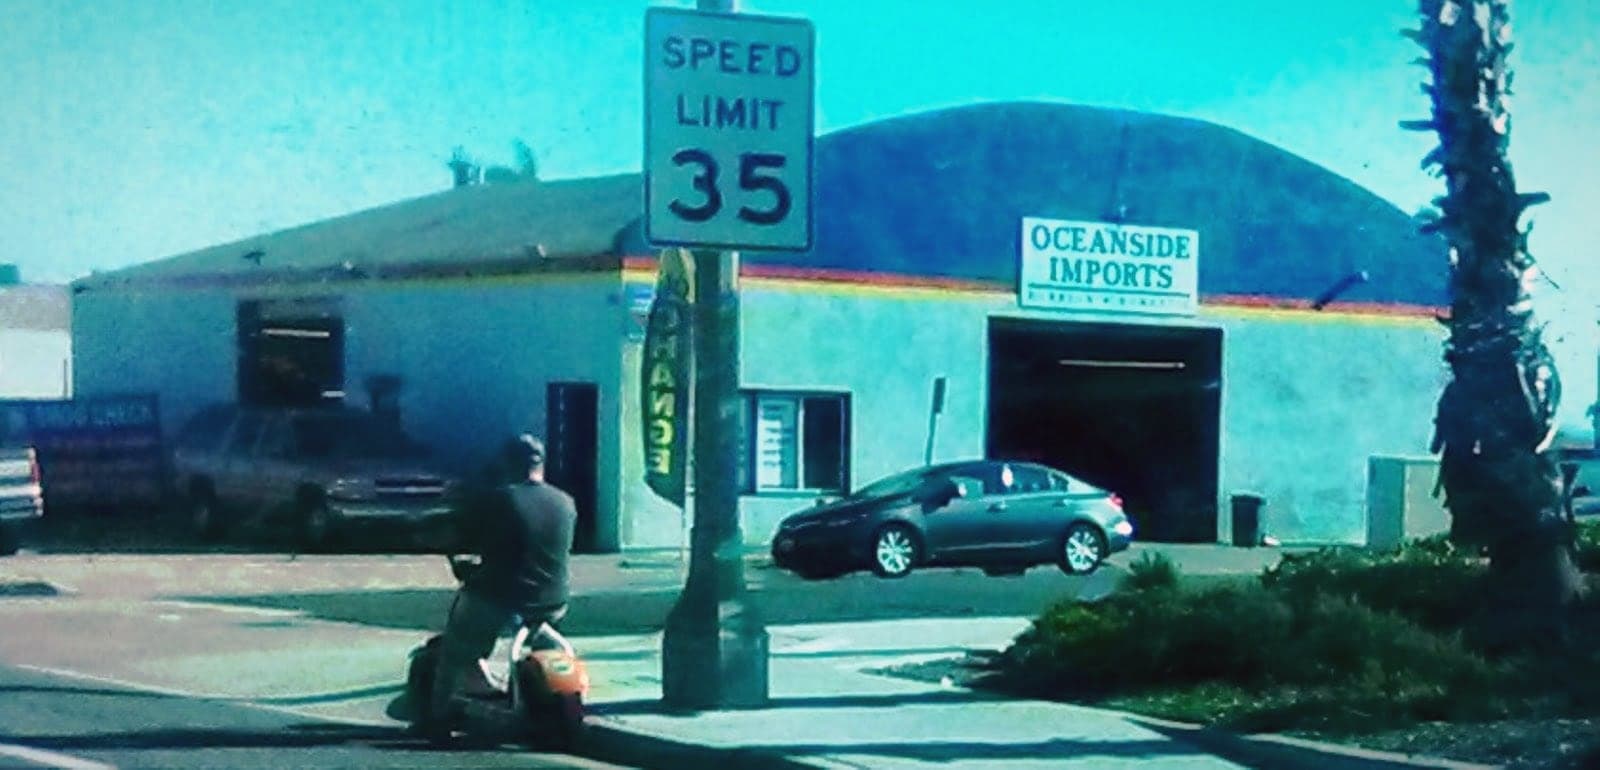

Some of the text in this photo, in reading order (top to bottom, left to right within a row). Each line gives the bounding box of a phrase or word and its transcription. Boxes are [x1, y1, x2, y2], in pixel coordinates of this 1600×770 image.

[662, 36, 801, 78] SPEED
[676, 93, 785, 131] LIMIT
[668, 148, 792, 226] 35
[1031, 224, 1191, 259] OCEANSIDE
[1049, 256, 1173, 289] IMPORTS
